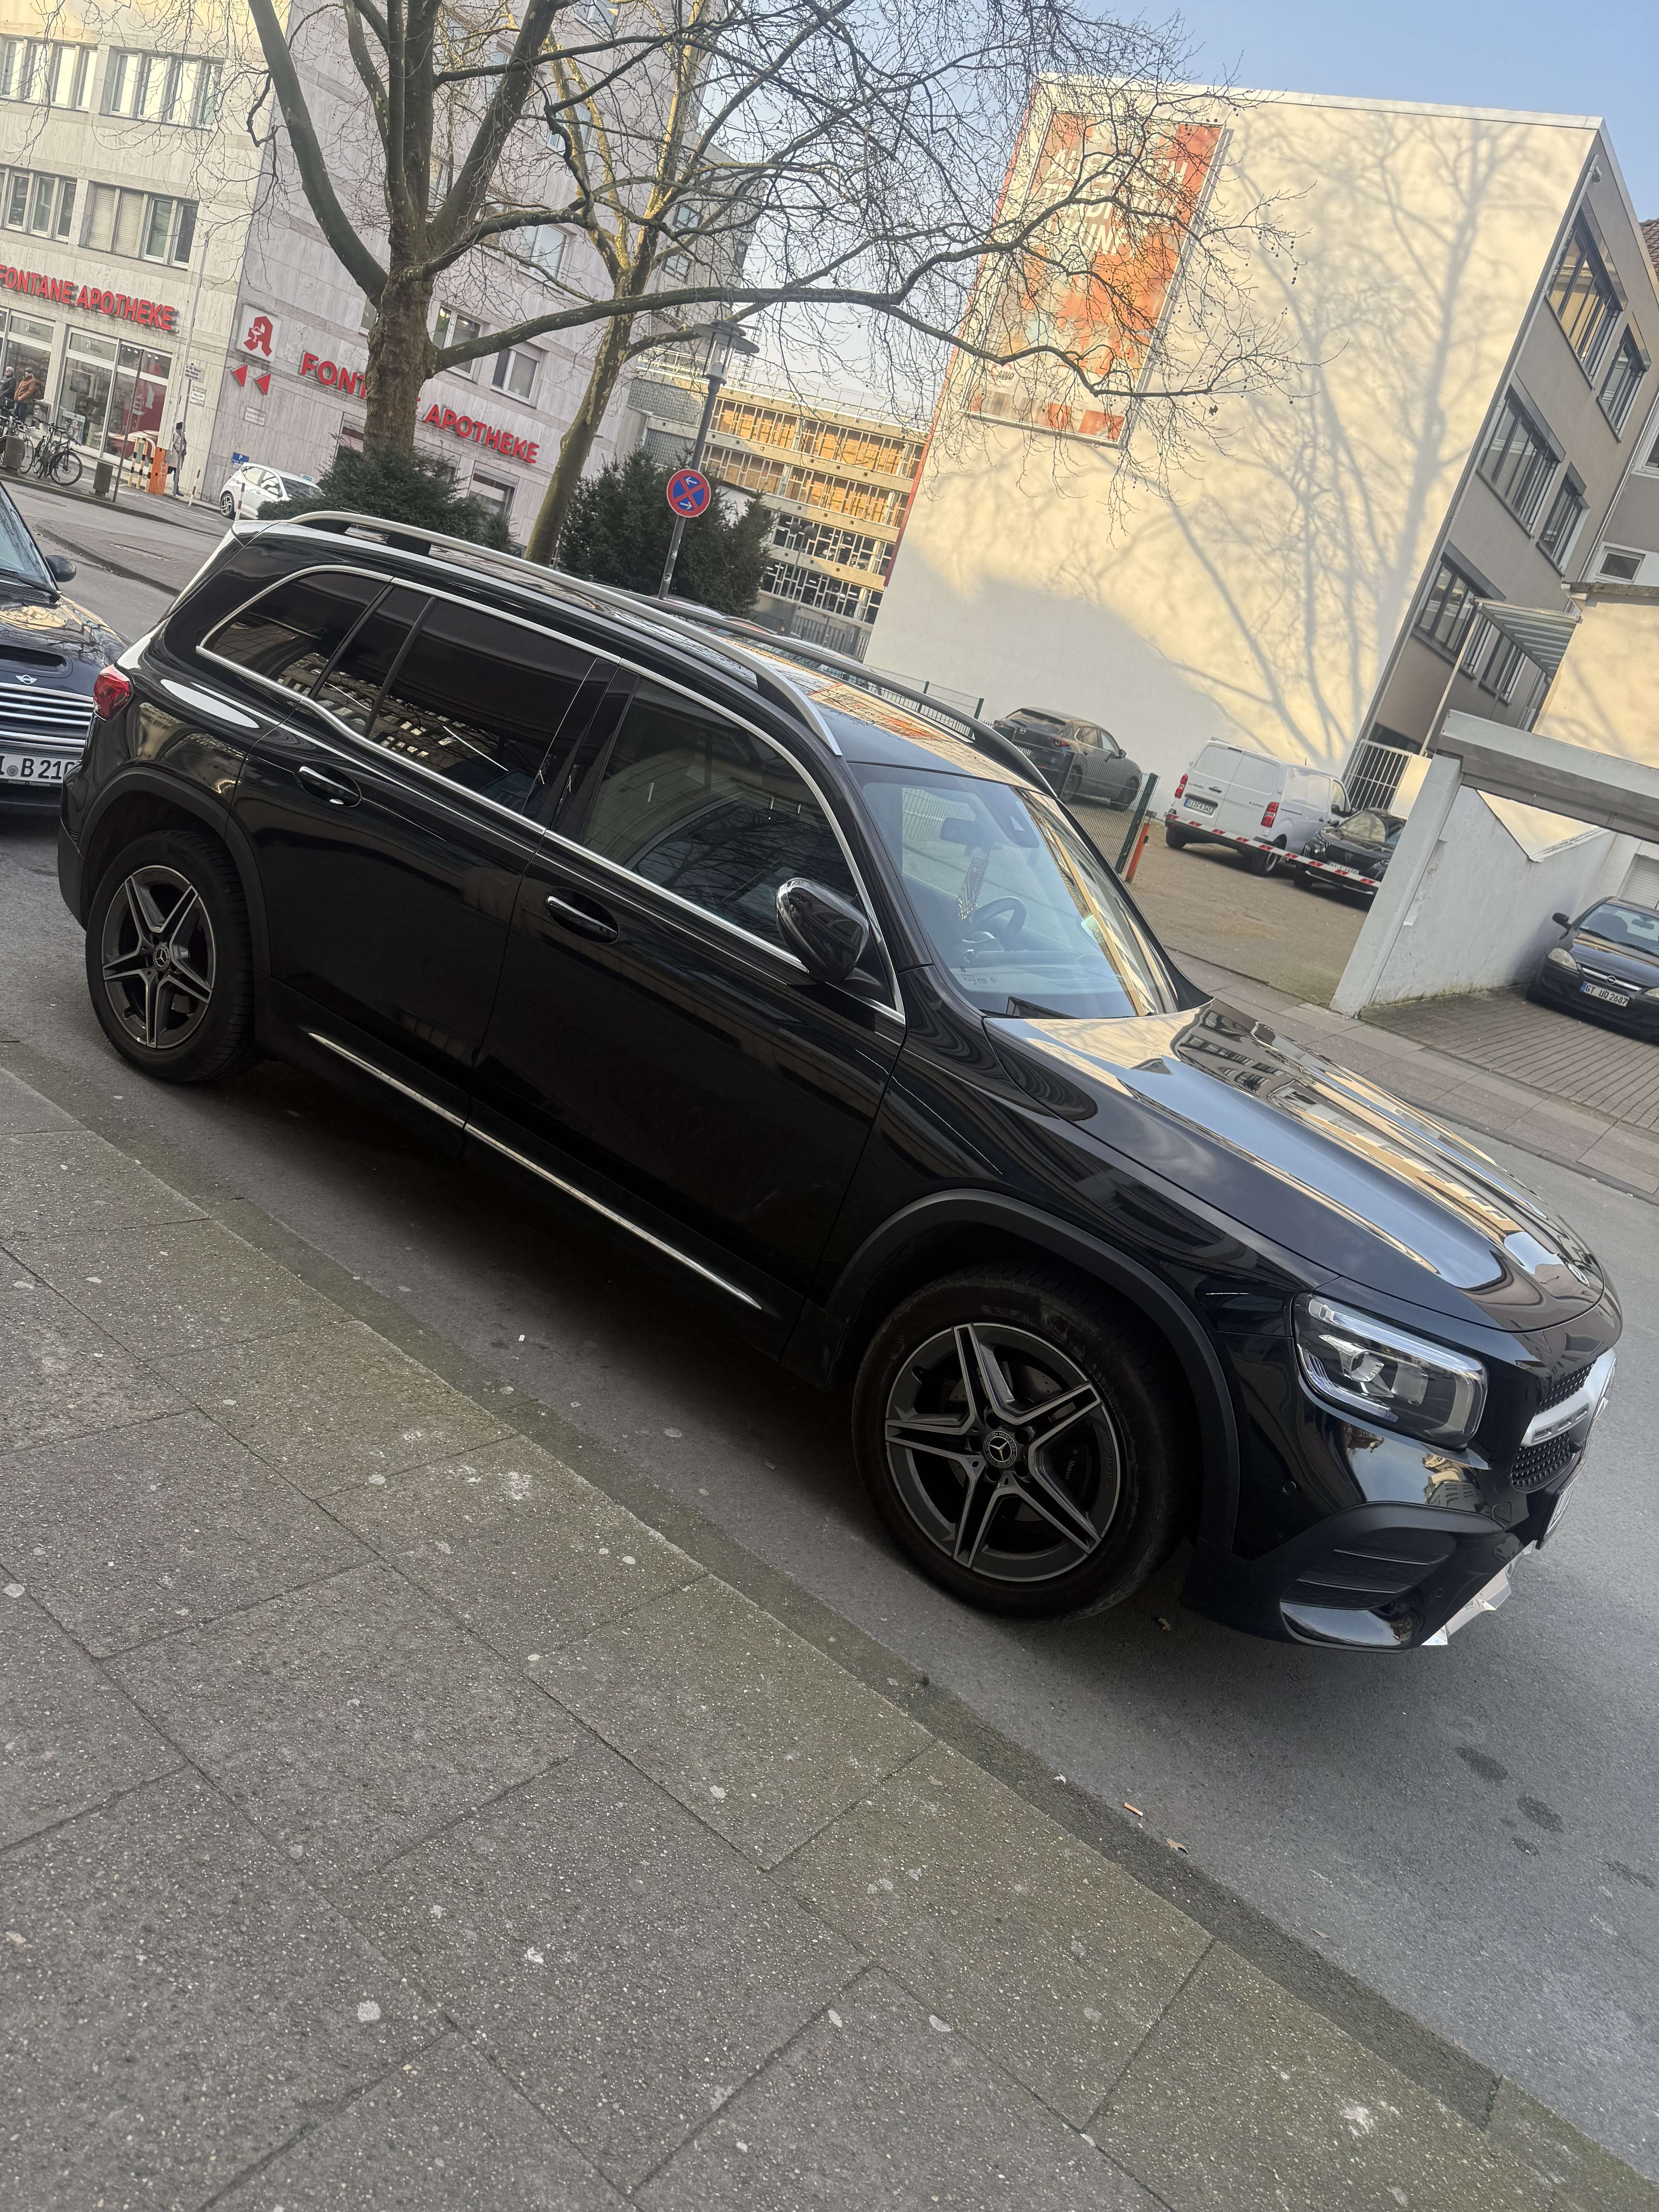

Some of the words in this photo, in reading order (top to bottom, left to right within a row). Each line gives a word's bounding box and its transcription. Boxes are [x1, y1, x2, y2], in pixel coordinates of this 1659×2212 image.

[1042, 182, 1176, 228] TRADIION
[1029, 214, 1149, 259] UKUNF
[75, 285, 174, 330] APOTHEKE
[996, 370, 1015, 380] AWO
[424, 404, 540, 464] APOTHEKE
[21, 758, 34, 777] B
[1585, 985, 1595, 993] GT
[1609, 993, 1628, 1005] 2687
